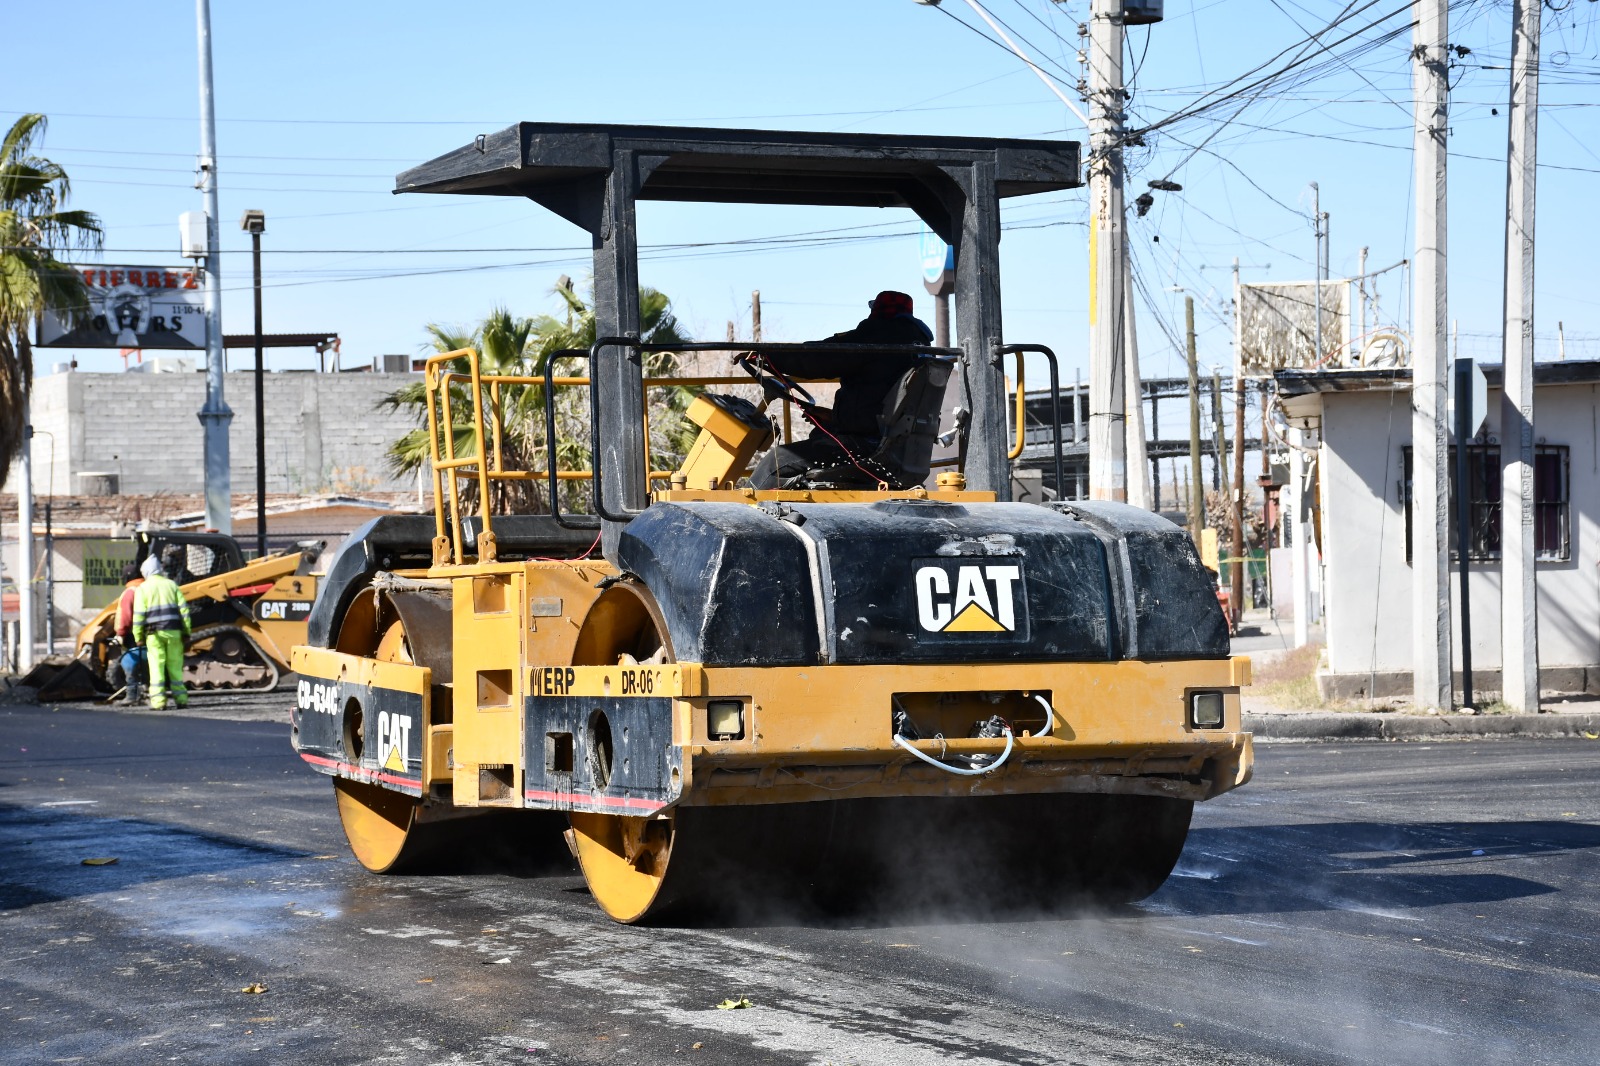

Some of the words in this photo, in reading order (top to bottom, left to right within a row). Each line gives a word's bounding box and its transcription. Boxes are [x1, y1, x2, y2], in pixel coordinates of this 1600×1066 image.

[83, 270, 199, 289] TIERREZ
[261, 602, 287, 619] CAT
[916, 566, 1019, 632] CAT
[621, 669, 653, 694] DR-06
[297, 680, 338, 716] CB-634C
[377, 710, 412, 773] CAT
